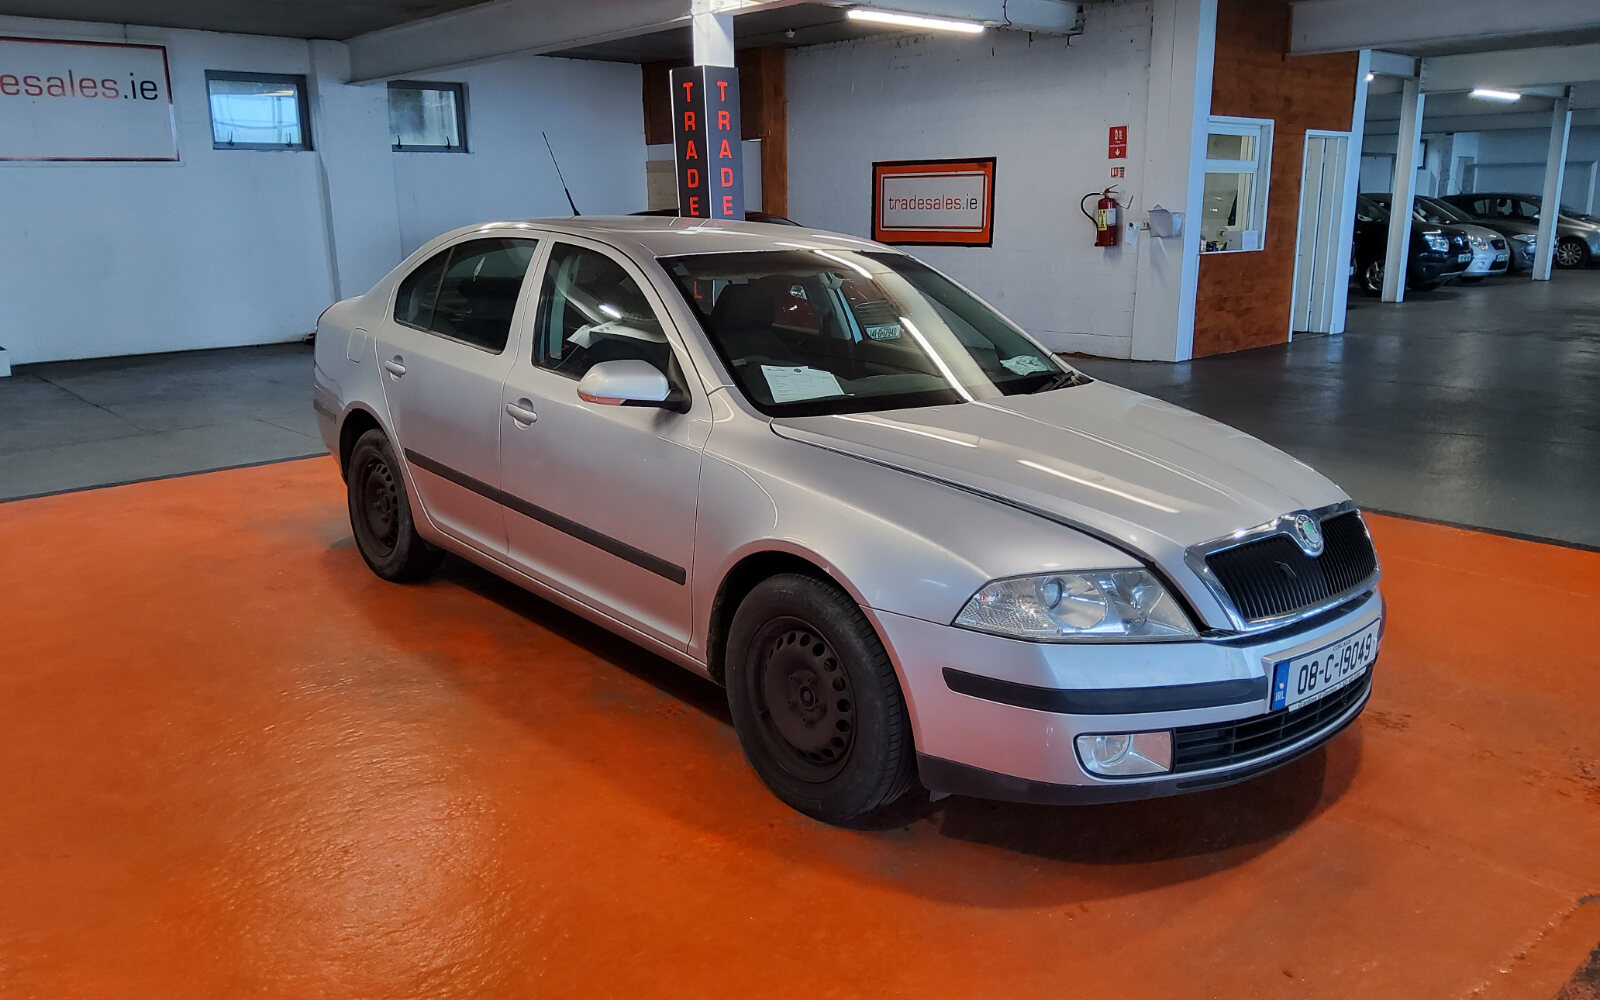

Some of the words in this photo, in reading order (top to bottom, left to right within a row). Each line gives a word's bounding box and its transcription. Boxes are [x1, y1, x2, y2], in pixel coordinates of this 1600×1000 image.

[683, 81, 700, 216] TRADE
[716, 81, 734, 215] TRADE
[888, 194, 978, 210] tradesales.ie
[1298, 633, 1372, 695] 08-C-19049
